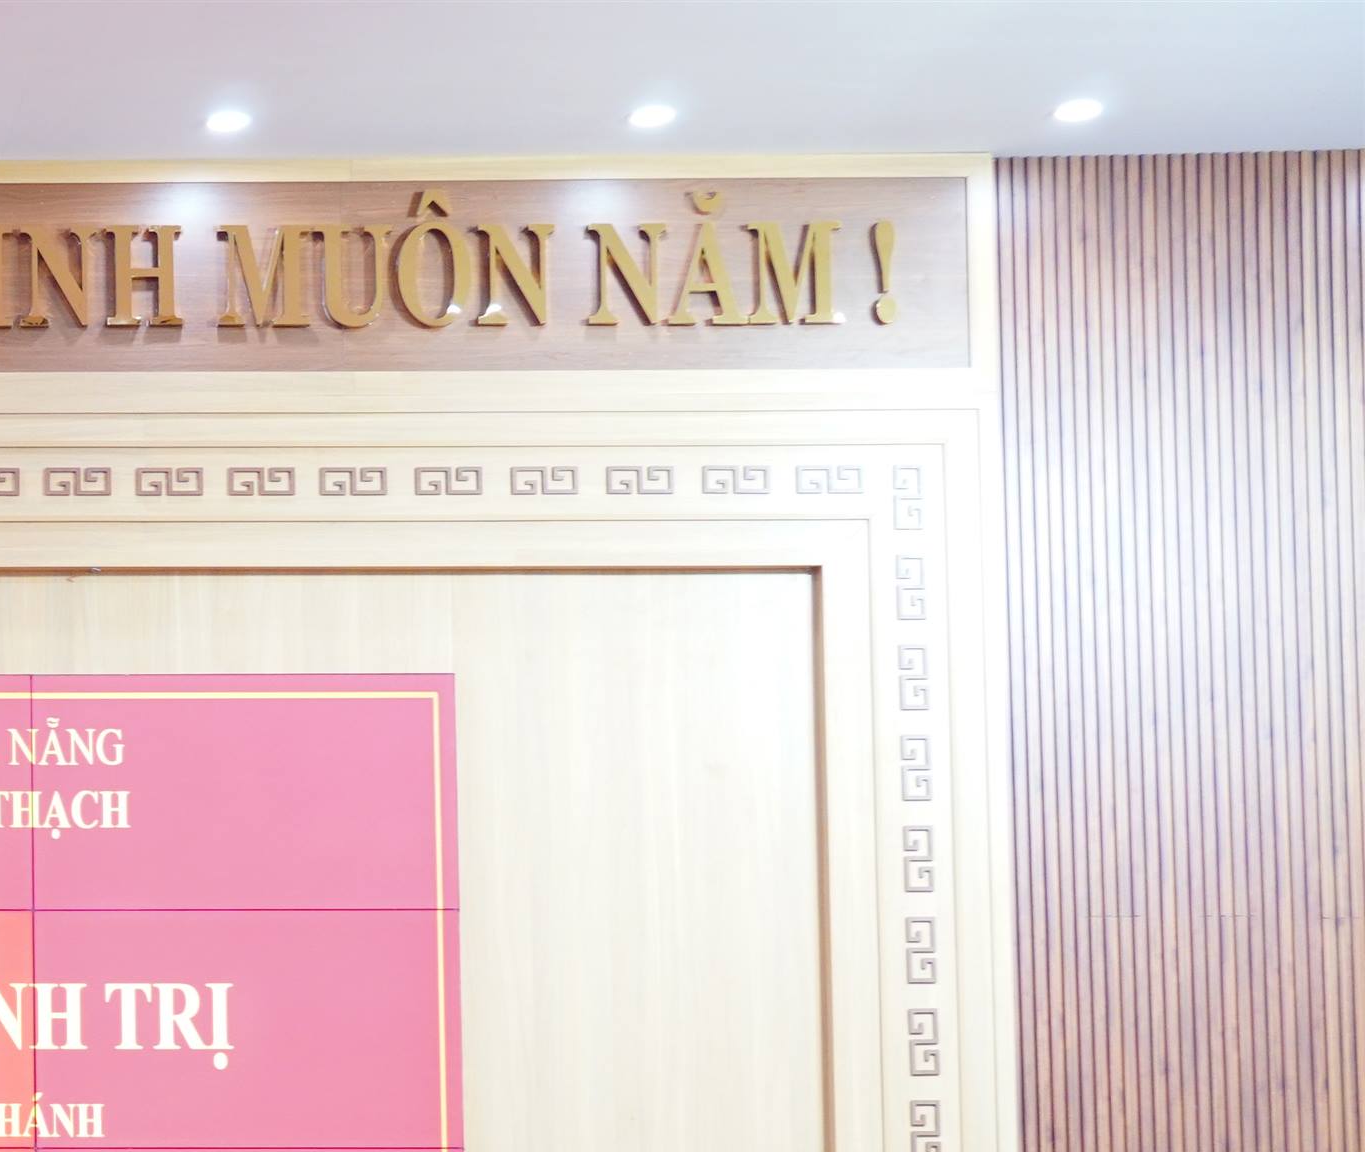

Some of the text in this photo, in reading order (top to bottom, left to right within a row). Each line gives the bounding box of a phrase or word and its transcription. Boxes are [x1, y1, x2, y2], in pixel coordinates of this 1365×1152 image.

[216, 190, 555, 330] MUÔN
[585, 191, 843, 327] NĂM
[871, 220, 898, 326] !
[7, 716, 125, 766] NẴNG
[105, 982, 234, 1070] TRỊ
